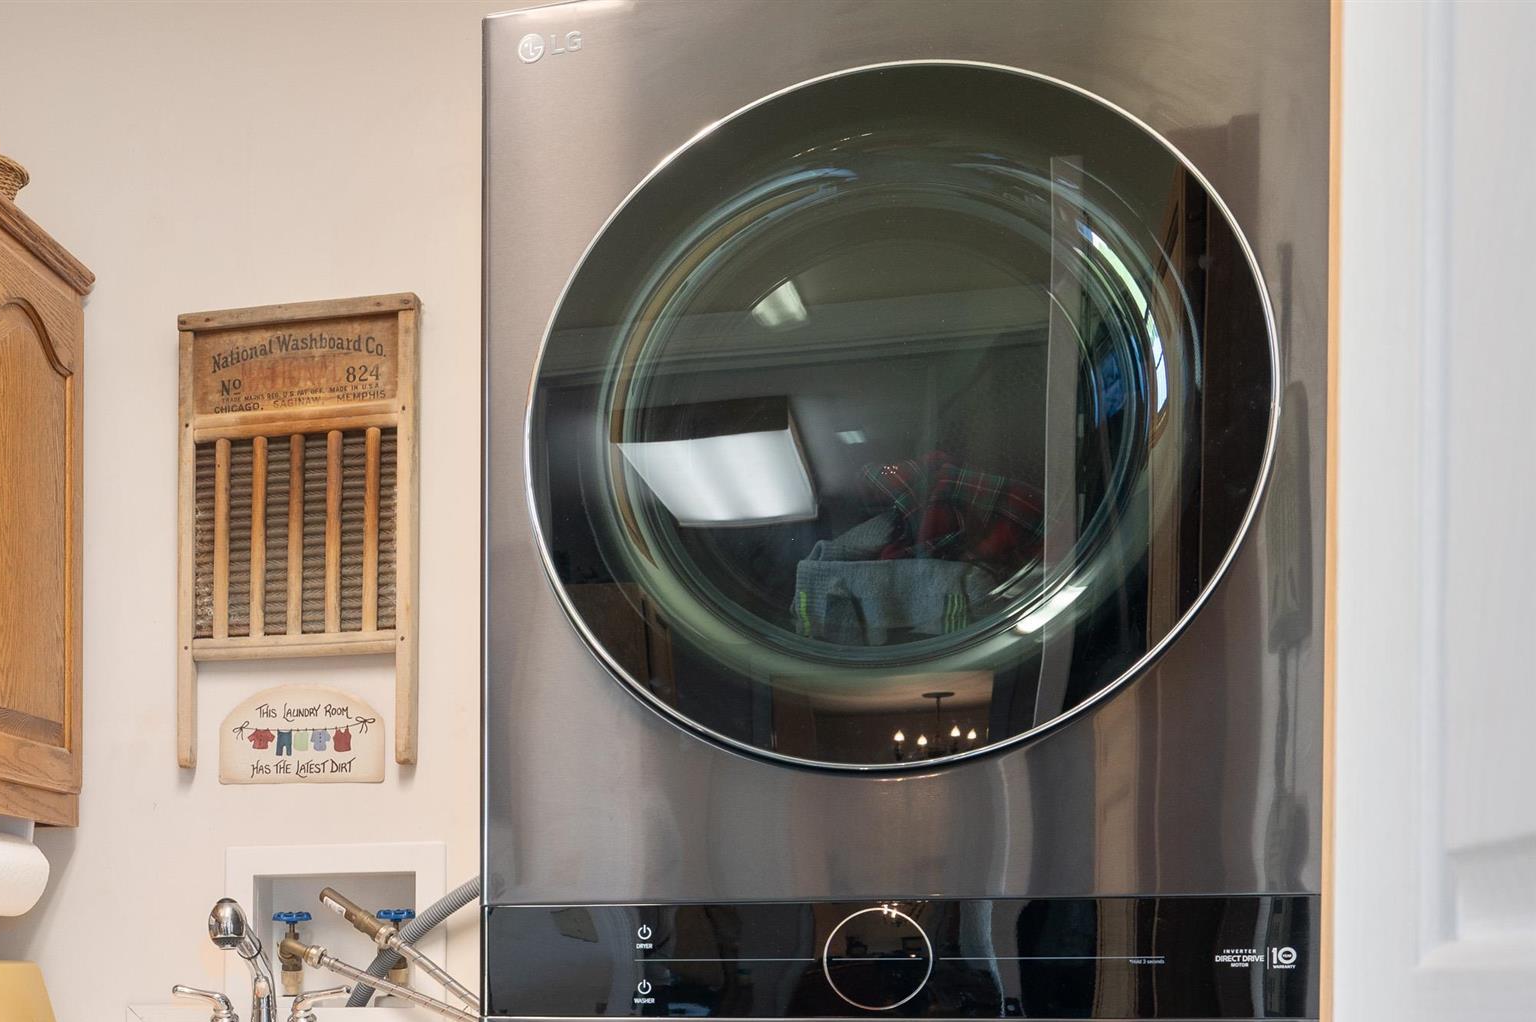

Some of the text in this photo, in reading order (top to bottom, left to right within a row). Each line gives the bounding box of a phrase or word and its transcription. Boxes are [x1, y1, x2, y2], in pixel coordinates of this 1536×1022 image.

[550, 30, 582, 55] LG
[211, 333, 386, 374] National Washboard Co.
[345, 364, 381, 383] 824
[329, 385, 347, 393] MADE
[336, 390, 386, 401] MEMPHIS
[255, 702, 352, 722] THIS LAUNDRY ROOM
[250, 757, 356, 779] HAS THE LATEST DIRT
